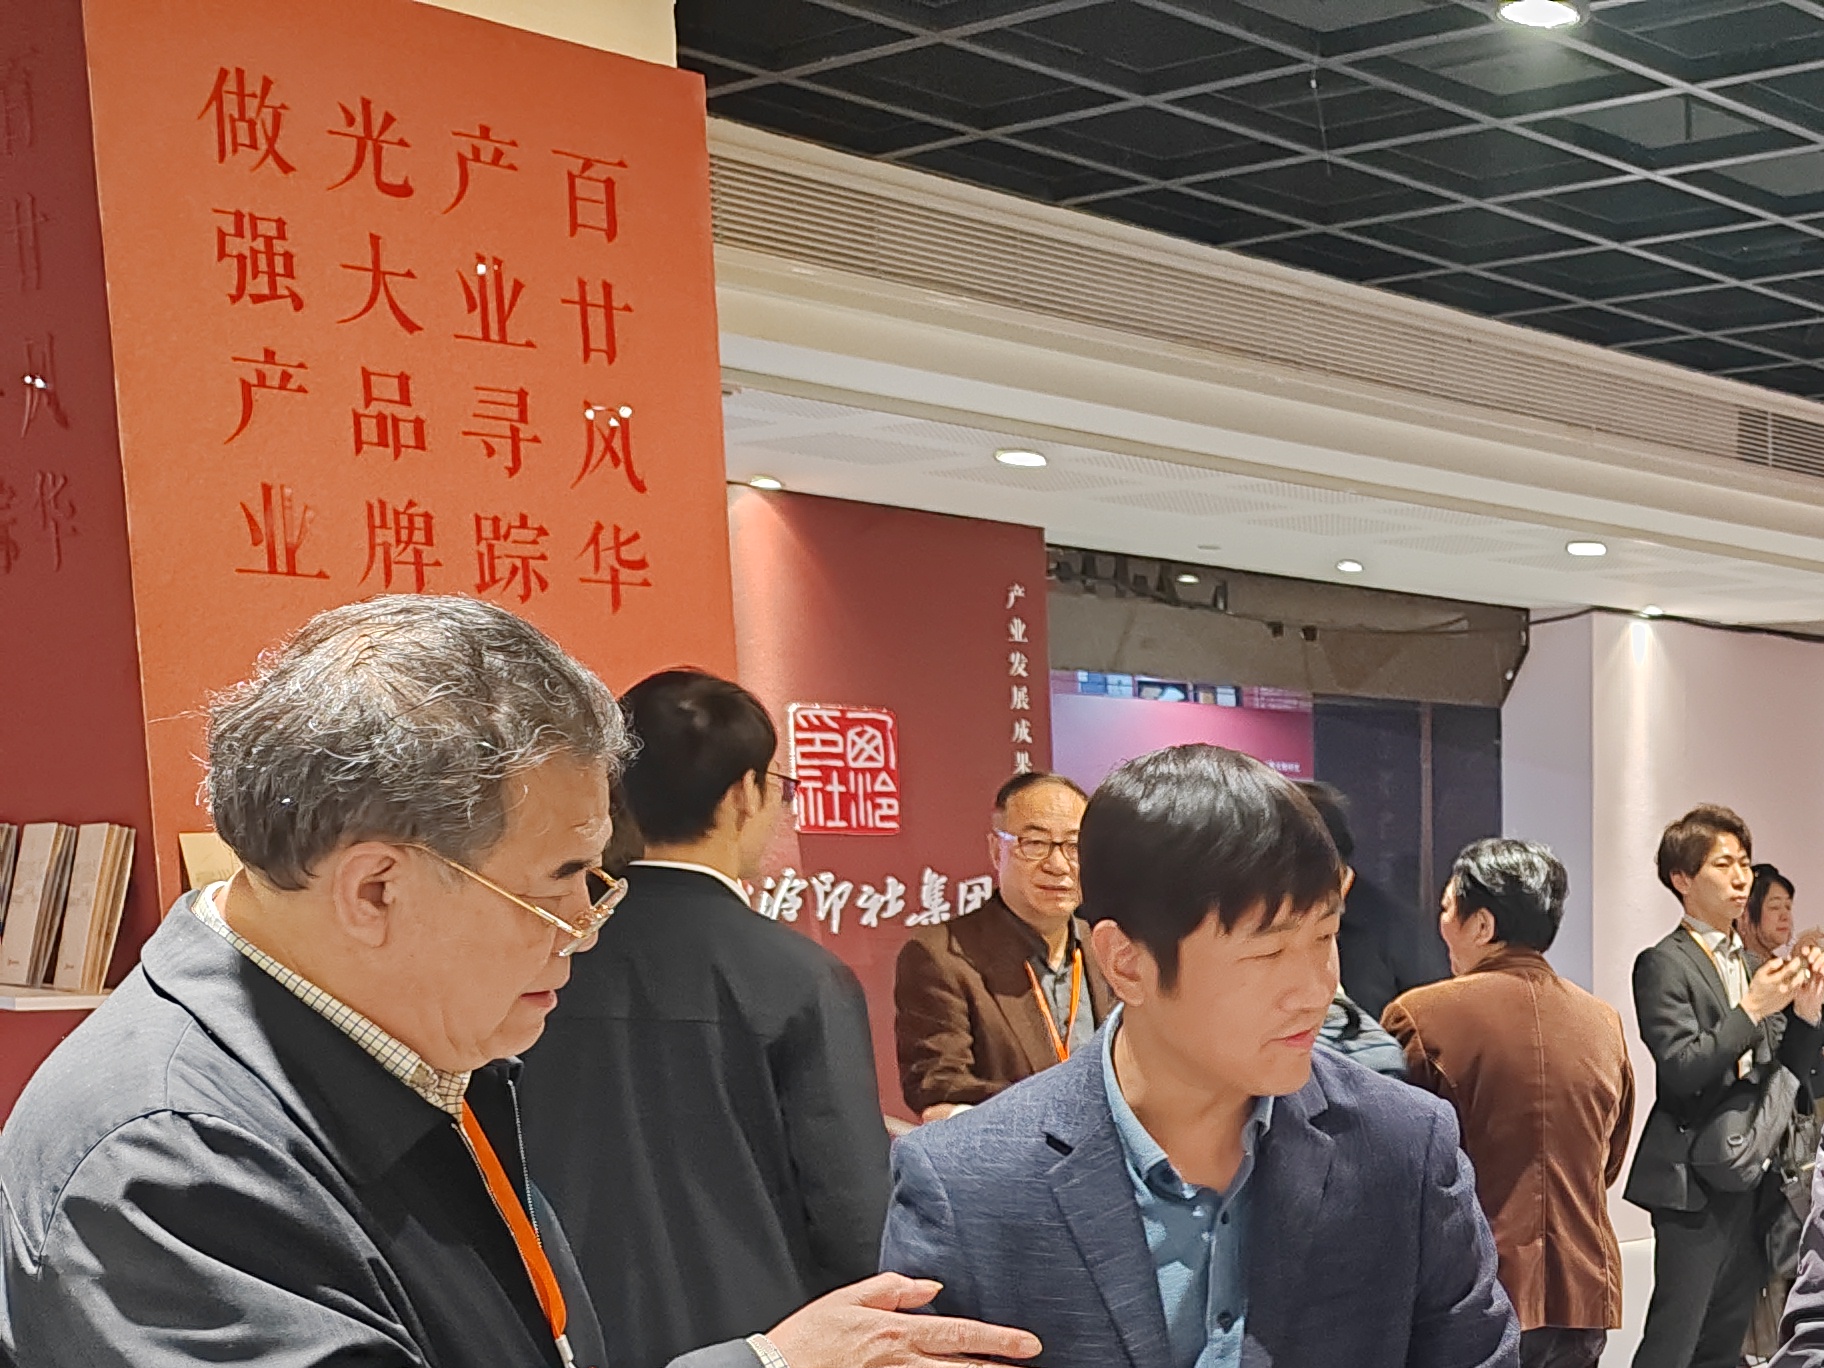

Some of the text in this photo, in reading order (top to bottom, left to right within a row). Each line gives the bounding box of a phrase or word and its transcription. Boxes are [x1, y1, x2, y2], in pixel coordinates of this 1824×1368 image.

[198, 66, 330, 583] 做强产业
[326, 97, 445, 598] 光大品牌
[443, 124, 550, 604] 产业寻踪
[552, 148, 655, 615] 百廿风华
[1005, 582, 1034, 774] 产业发展成果
